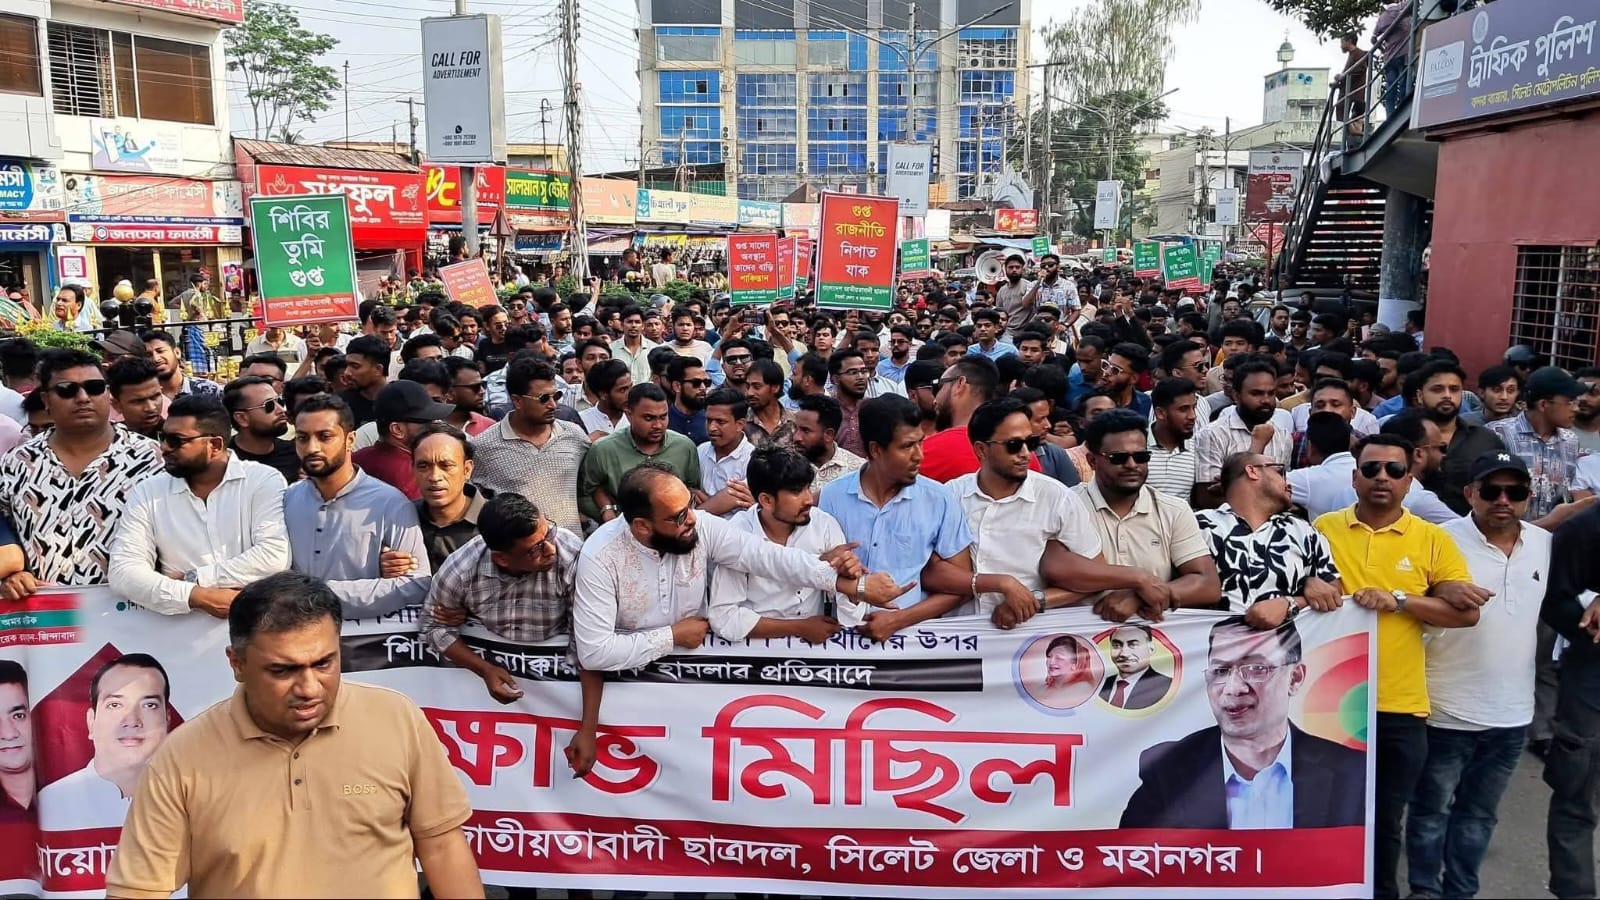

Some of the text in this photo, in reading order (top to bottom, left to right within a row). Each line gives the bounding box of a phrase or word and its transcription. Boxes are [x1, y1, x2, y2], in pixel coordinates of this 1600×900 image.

[431, 50, 481, 67] CALL FOR
[1467, 15, 1597, 88] ট্রাফিক পুলিশ
[432, 67, 481, 79] ADVERTISEMENT
[912, 162, 924, 170] FOR
[268, 205, 331, 232] শিবির
[852, 204, 872, 218] গুপ্ত
[109, 229, 164, 240] জনসেবা
[834, 220, 887, 238] রাজনীতি
[280, 233, 326, 266] তুমি
[840, 241, 878, 259] নিপাত
[289, 266, 325, 287] গুপ্ত
[845, 264, 870, 278] যাক
[918, 629, 979, 651] উপর
[657, 661, 752, 681] হামলার
[760, 660, 876, 686] প্রতিবাদে
[701, 694, 1083, 823] মিছিল
[680, 835, 812, 874] ছাত্রদল,
[824, 834, 940, 873] সিলেট
[952, 843, 1045, 875] জেলা
[1056, 846, 1084, 871] ও
[1096, 841, 1242, 878] মহানগর
